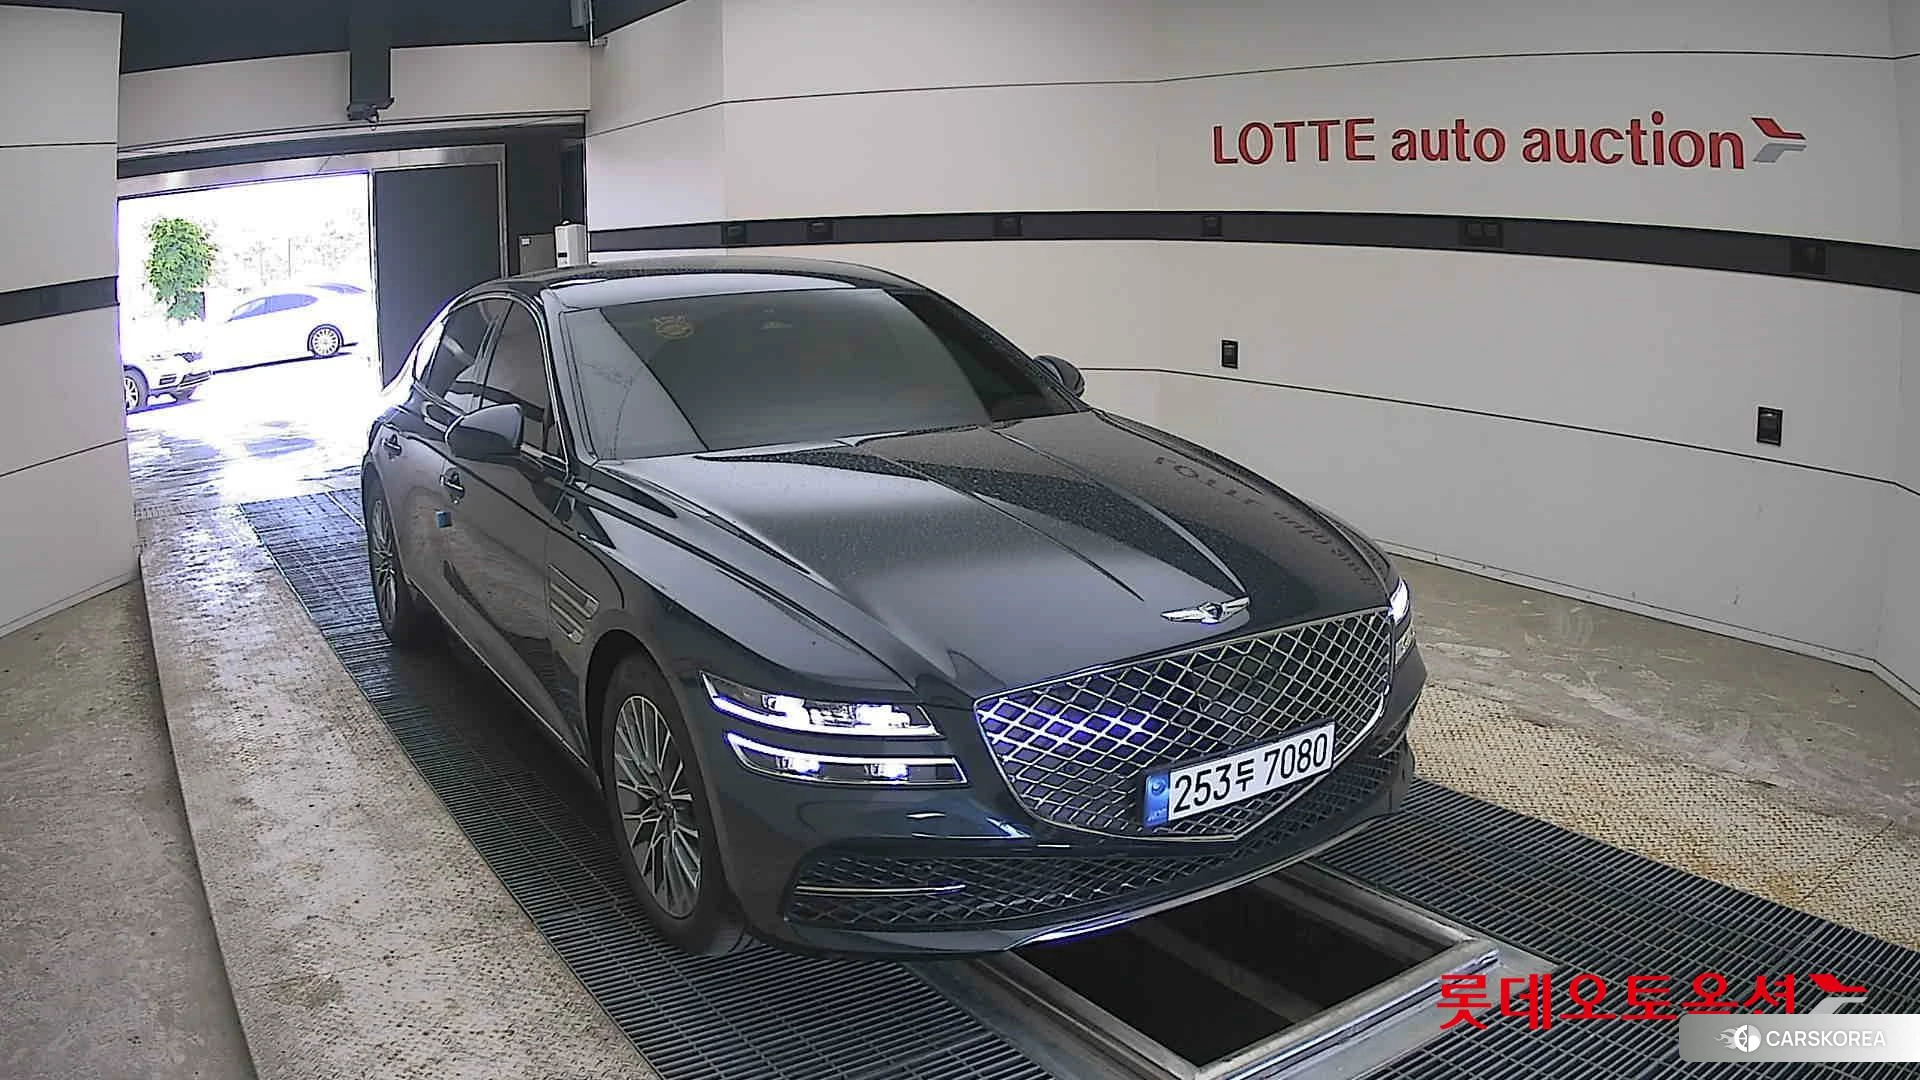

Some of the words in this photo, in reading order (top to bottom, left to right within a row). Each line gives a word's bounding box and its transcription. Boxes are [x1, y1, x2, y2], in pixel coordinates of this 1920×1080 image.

[1212, 117, 1376, 165] LOTTE
[1391, 118, 1506, 163] auto
[1521, 110, 1745, 170] auction
[1173, 758, 1255, 814] 253두
[1263, 733, 1328, 786] 7080
